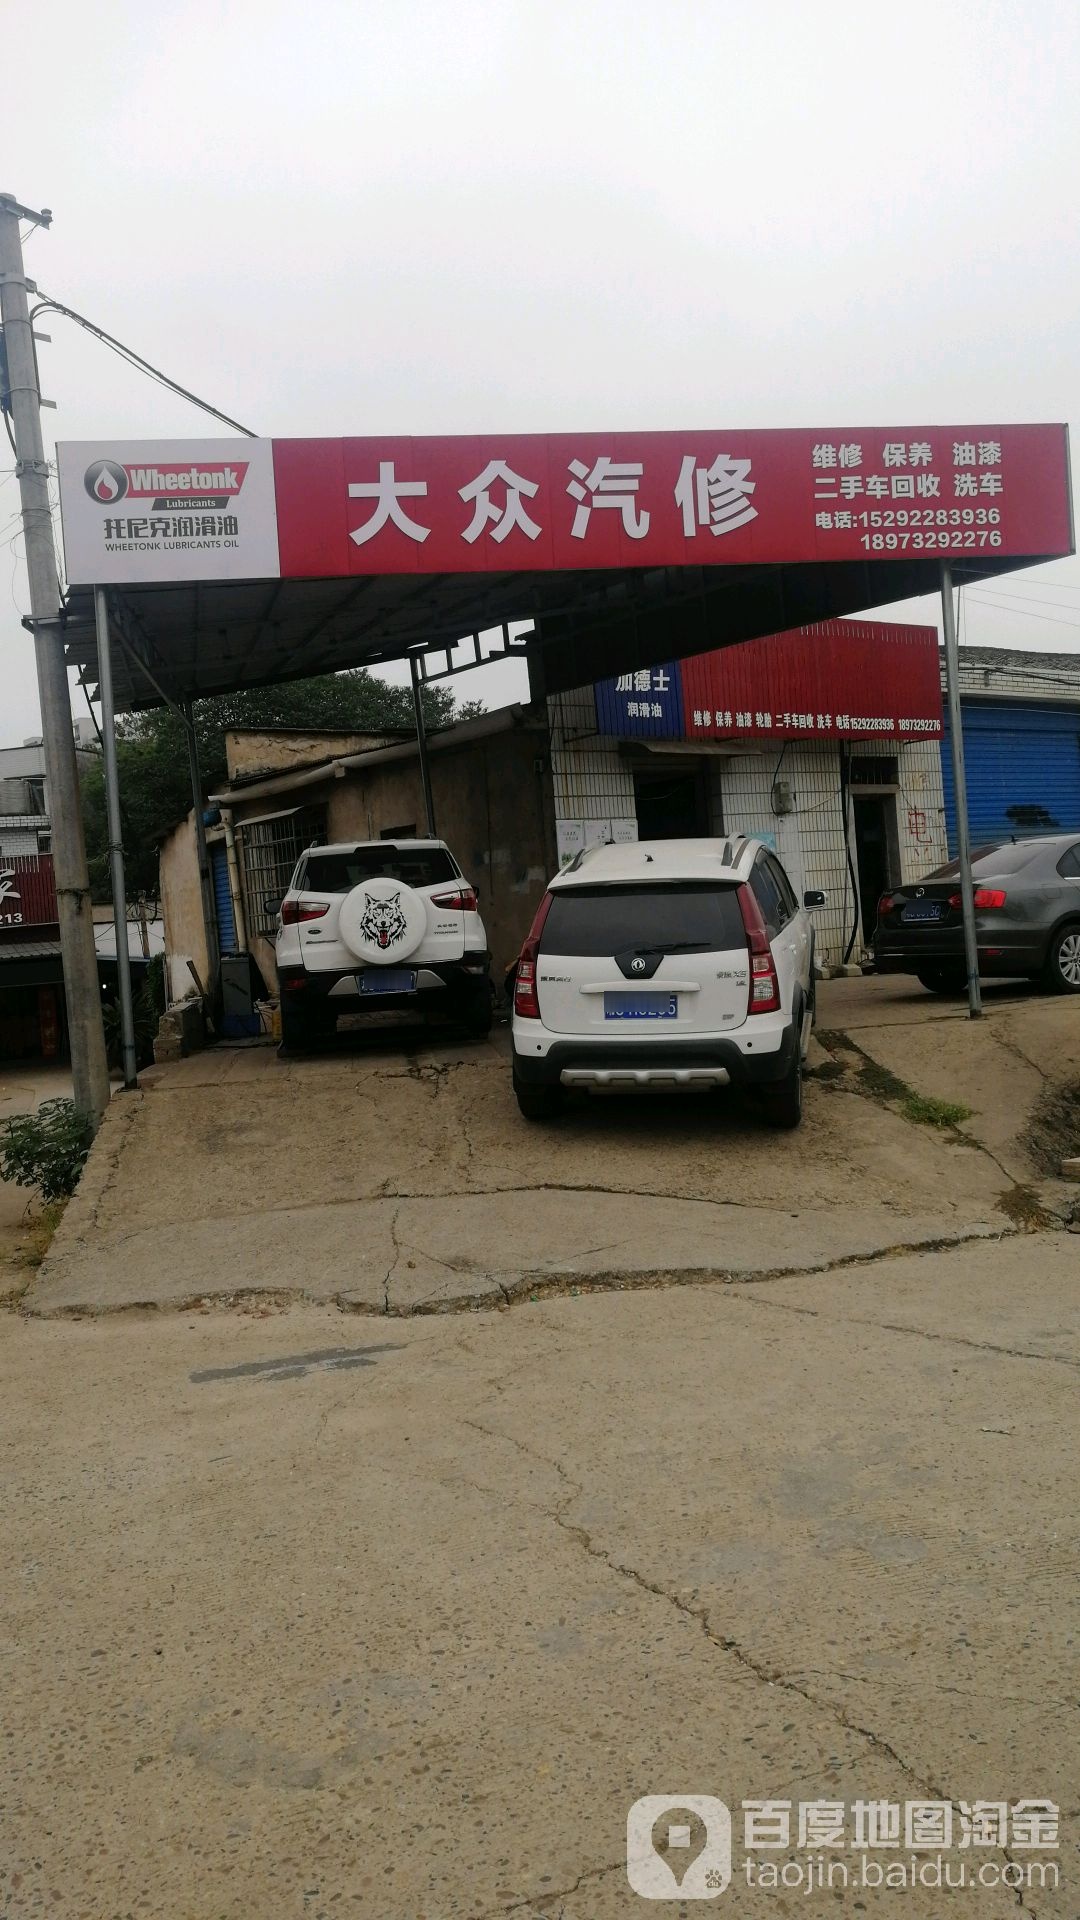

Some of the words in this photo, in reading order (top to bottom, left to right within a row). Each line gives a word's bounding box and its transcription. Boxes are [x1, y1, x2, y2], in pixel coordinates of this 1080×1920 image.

[812, 443, 863, 468] 维修
[882, 442, 933, 468] 保养
[952, 441, 1002, 466] 油漆
[130, 467, 239, 491] Wheetonk
[814, 473, 941, 499] 二手车回收
[953, 472, 1004, 497] 洗车
[166, 499, 216, 508] Lubricants
[348, 454, 759, 545] 大众汽修
[103, 515, 239, 539] 托尼克润滑油
[105, 542, 161, 551] WHEETONK
[164, 540, 221, 550] LUBRICANTS
[224, 539, 239, 548] OIL
[860, 530, 1002, 550] 18973292276
[627, 702, 663, 718] 润滑油
[693, 710, 712, 727] 维修
[715, 710, 733, 728] 保养
[735, 712, 753, 728] 油漆
[755, 712, 772, 729] 轮胎
[775, 712, 814, 729] 二手车回收
[816, 713, 833, 729] 洗车
